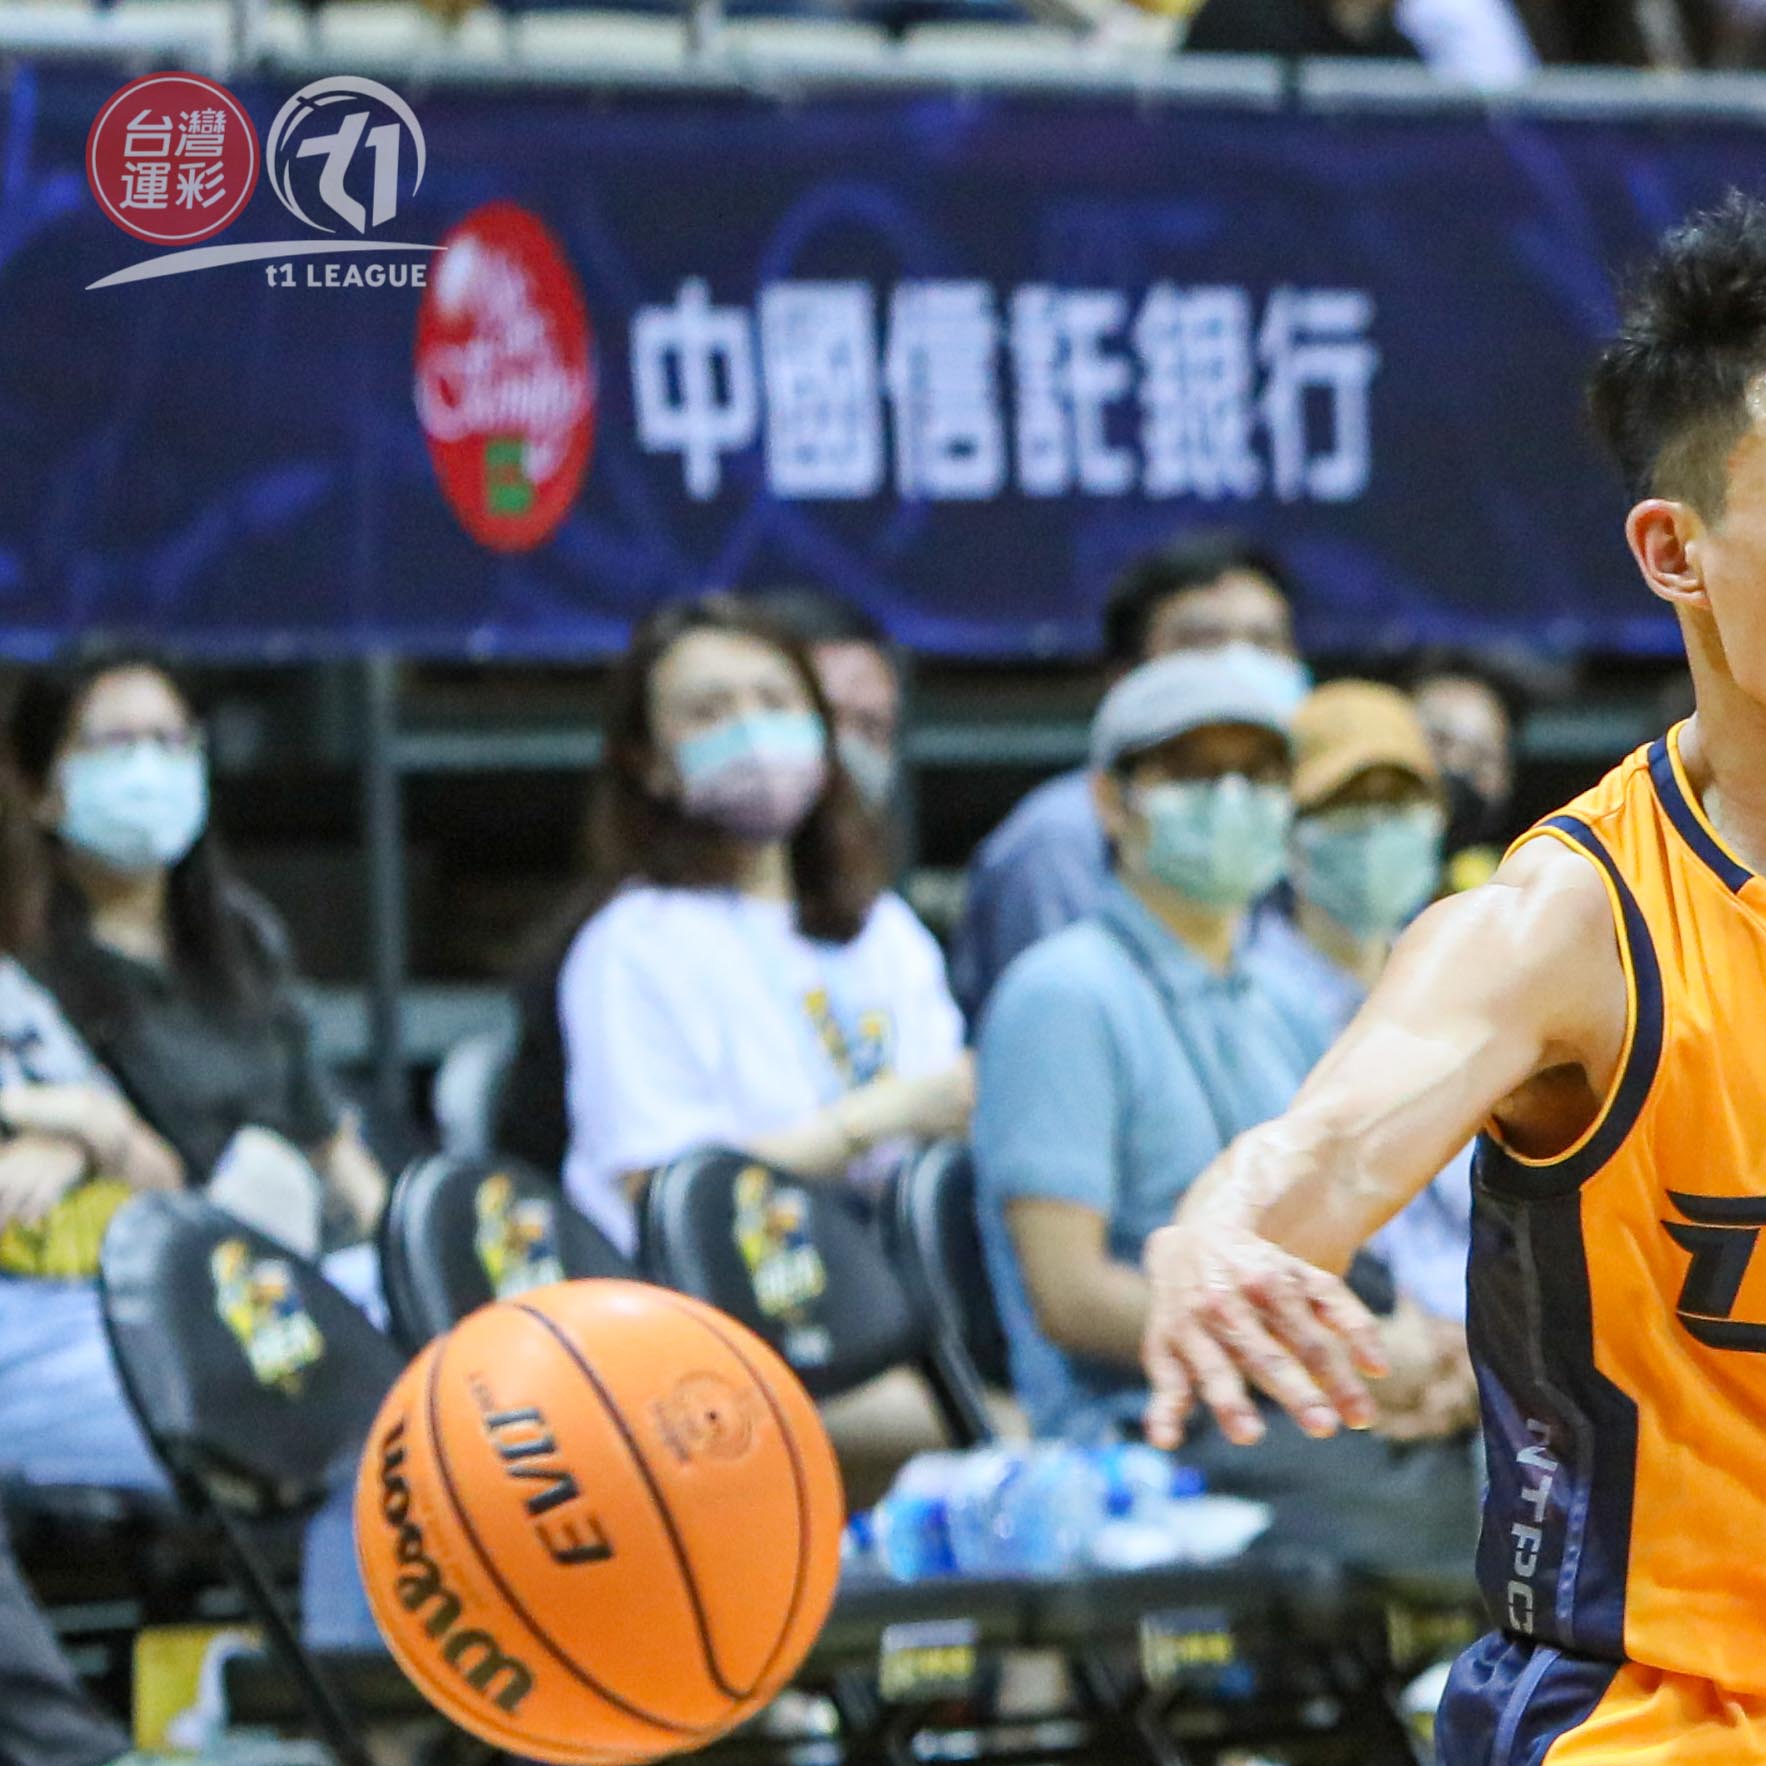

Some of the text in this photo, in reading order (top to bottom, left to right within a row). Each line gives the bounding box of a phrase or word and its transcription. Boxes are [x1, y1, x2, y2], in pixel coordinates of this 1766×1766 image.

[630, 276, 1380, 500] 中國信託銀行
[380, 1412, 535, 1715] Wilson
